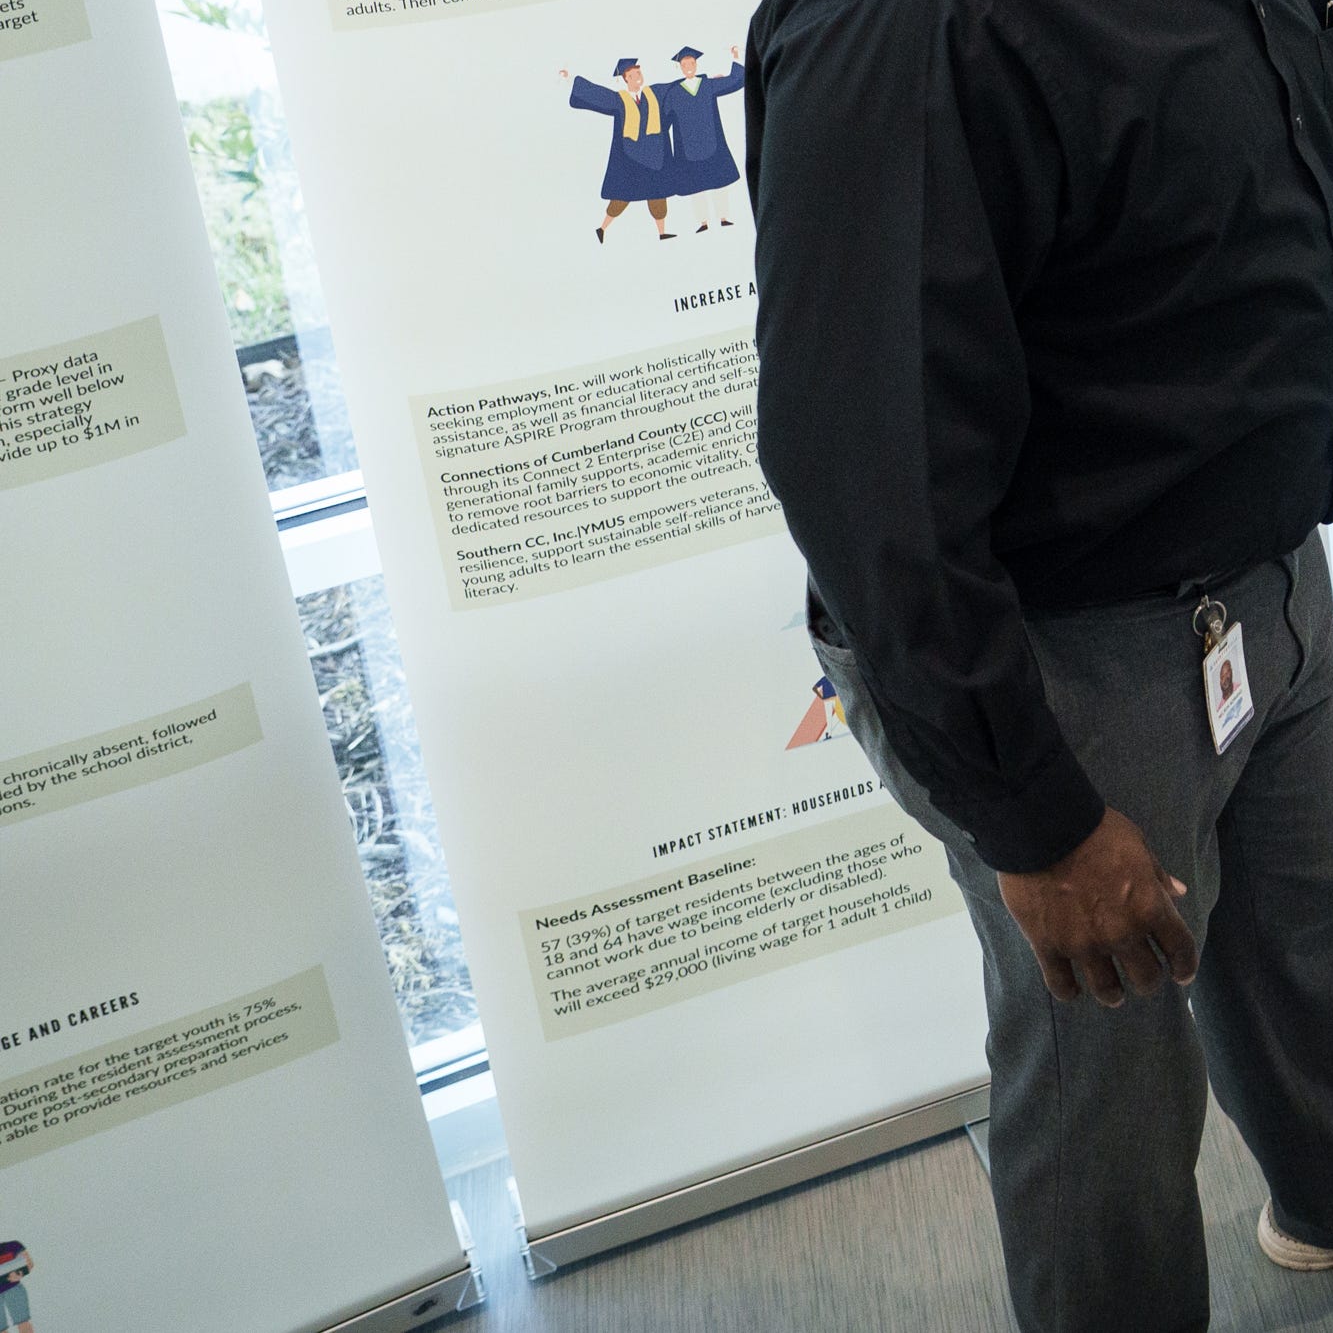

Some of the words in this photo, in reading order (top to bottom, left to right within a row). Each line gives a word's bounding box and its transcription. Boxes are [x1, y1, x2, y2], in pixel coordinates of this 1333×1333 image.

[674, 284, 742, 312] INCREASE
[12, 362, 58, 382] Proxy
[63, 352, 98, 371] data
[427, 403, 475, 418] Action
[478, 389, 551, 410] Pathways,
[554, 383, 579, 395] Inc.
[2, 753, 88, 785] chronically
[92, 735, 149, 759] absent,
[152, 708, 217, 741] followed
[652, 831, 701, 858] IMPACT
[707, 807, 786, 840] STATEMENT:
[792, 780, 873, 815] HOUSEHOLDS
[535, 909, 586, 930] Needs
[592, 879, 684, 916] Assessment
[687, 858, 756, 886] Baseline:
[28, 1019, 61, 1041] AND
[67, 992, 139, 1027] CAREERS
